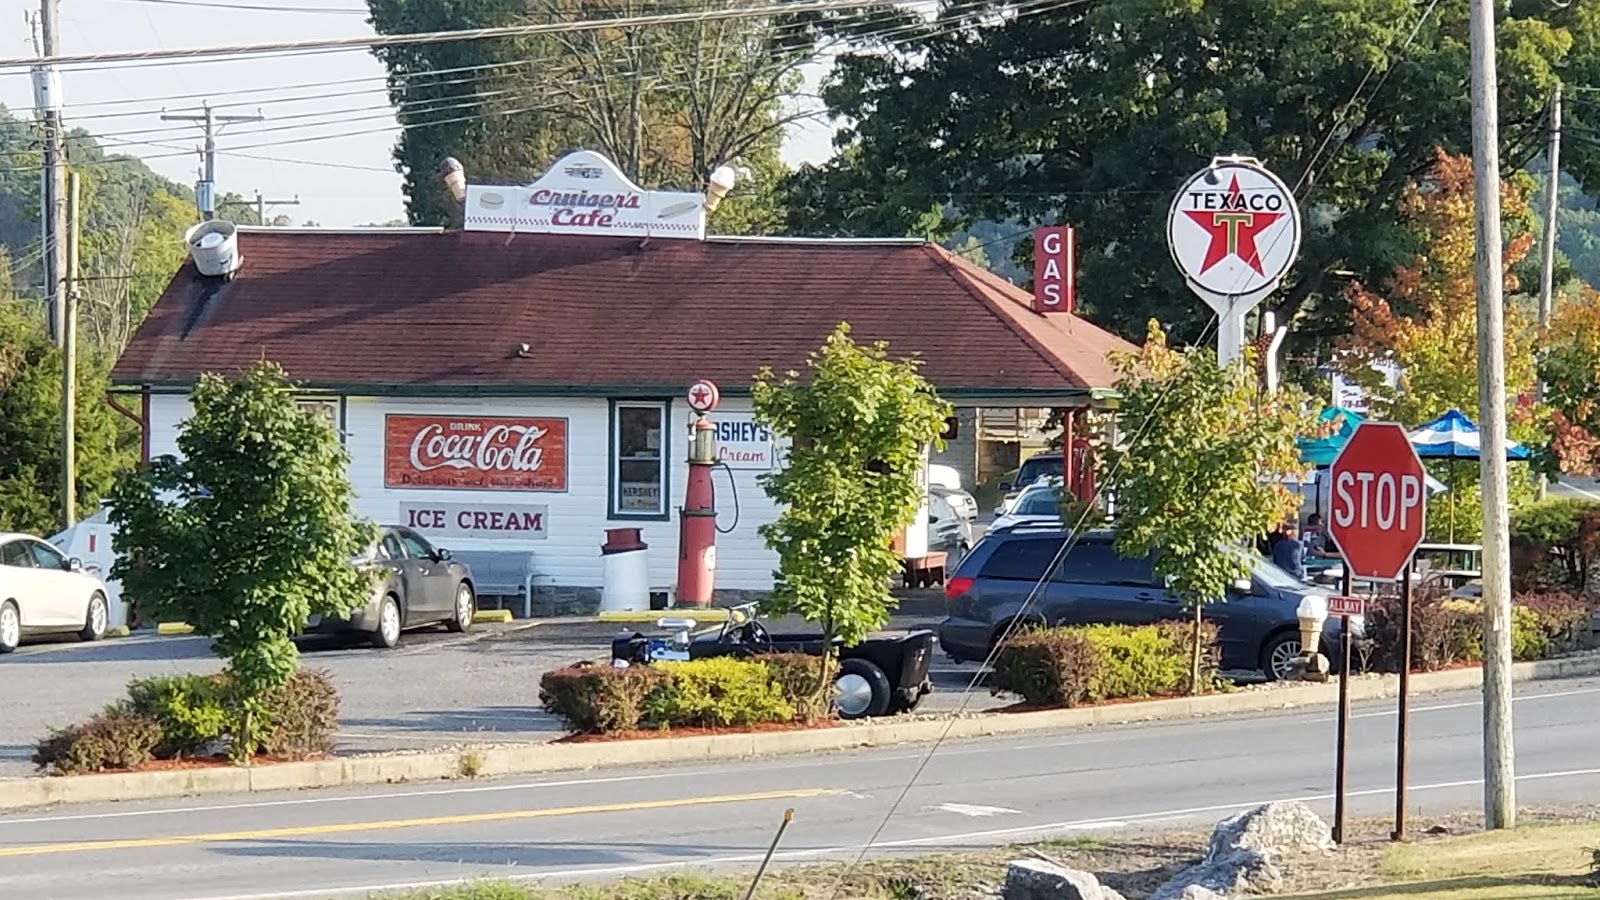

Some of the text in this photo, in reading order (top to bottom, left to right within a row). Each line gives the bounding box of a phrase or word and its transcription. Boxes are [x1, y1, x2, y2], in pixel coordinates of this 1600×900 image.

[529, 189, 641, 209] Cruiser's
[1188, 191, 1283, 212] TEXACO
[1041, 233, 1062, 306] GAS
[450, 422, 482, 432] DRINK
[719, 446, 766, 462] Cream
[1334, 470, 1420, 531] STOP
[407, 509, 543, 531] ICE CREAM
